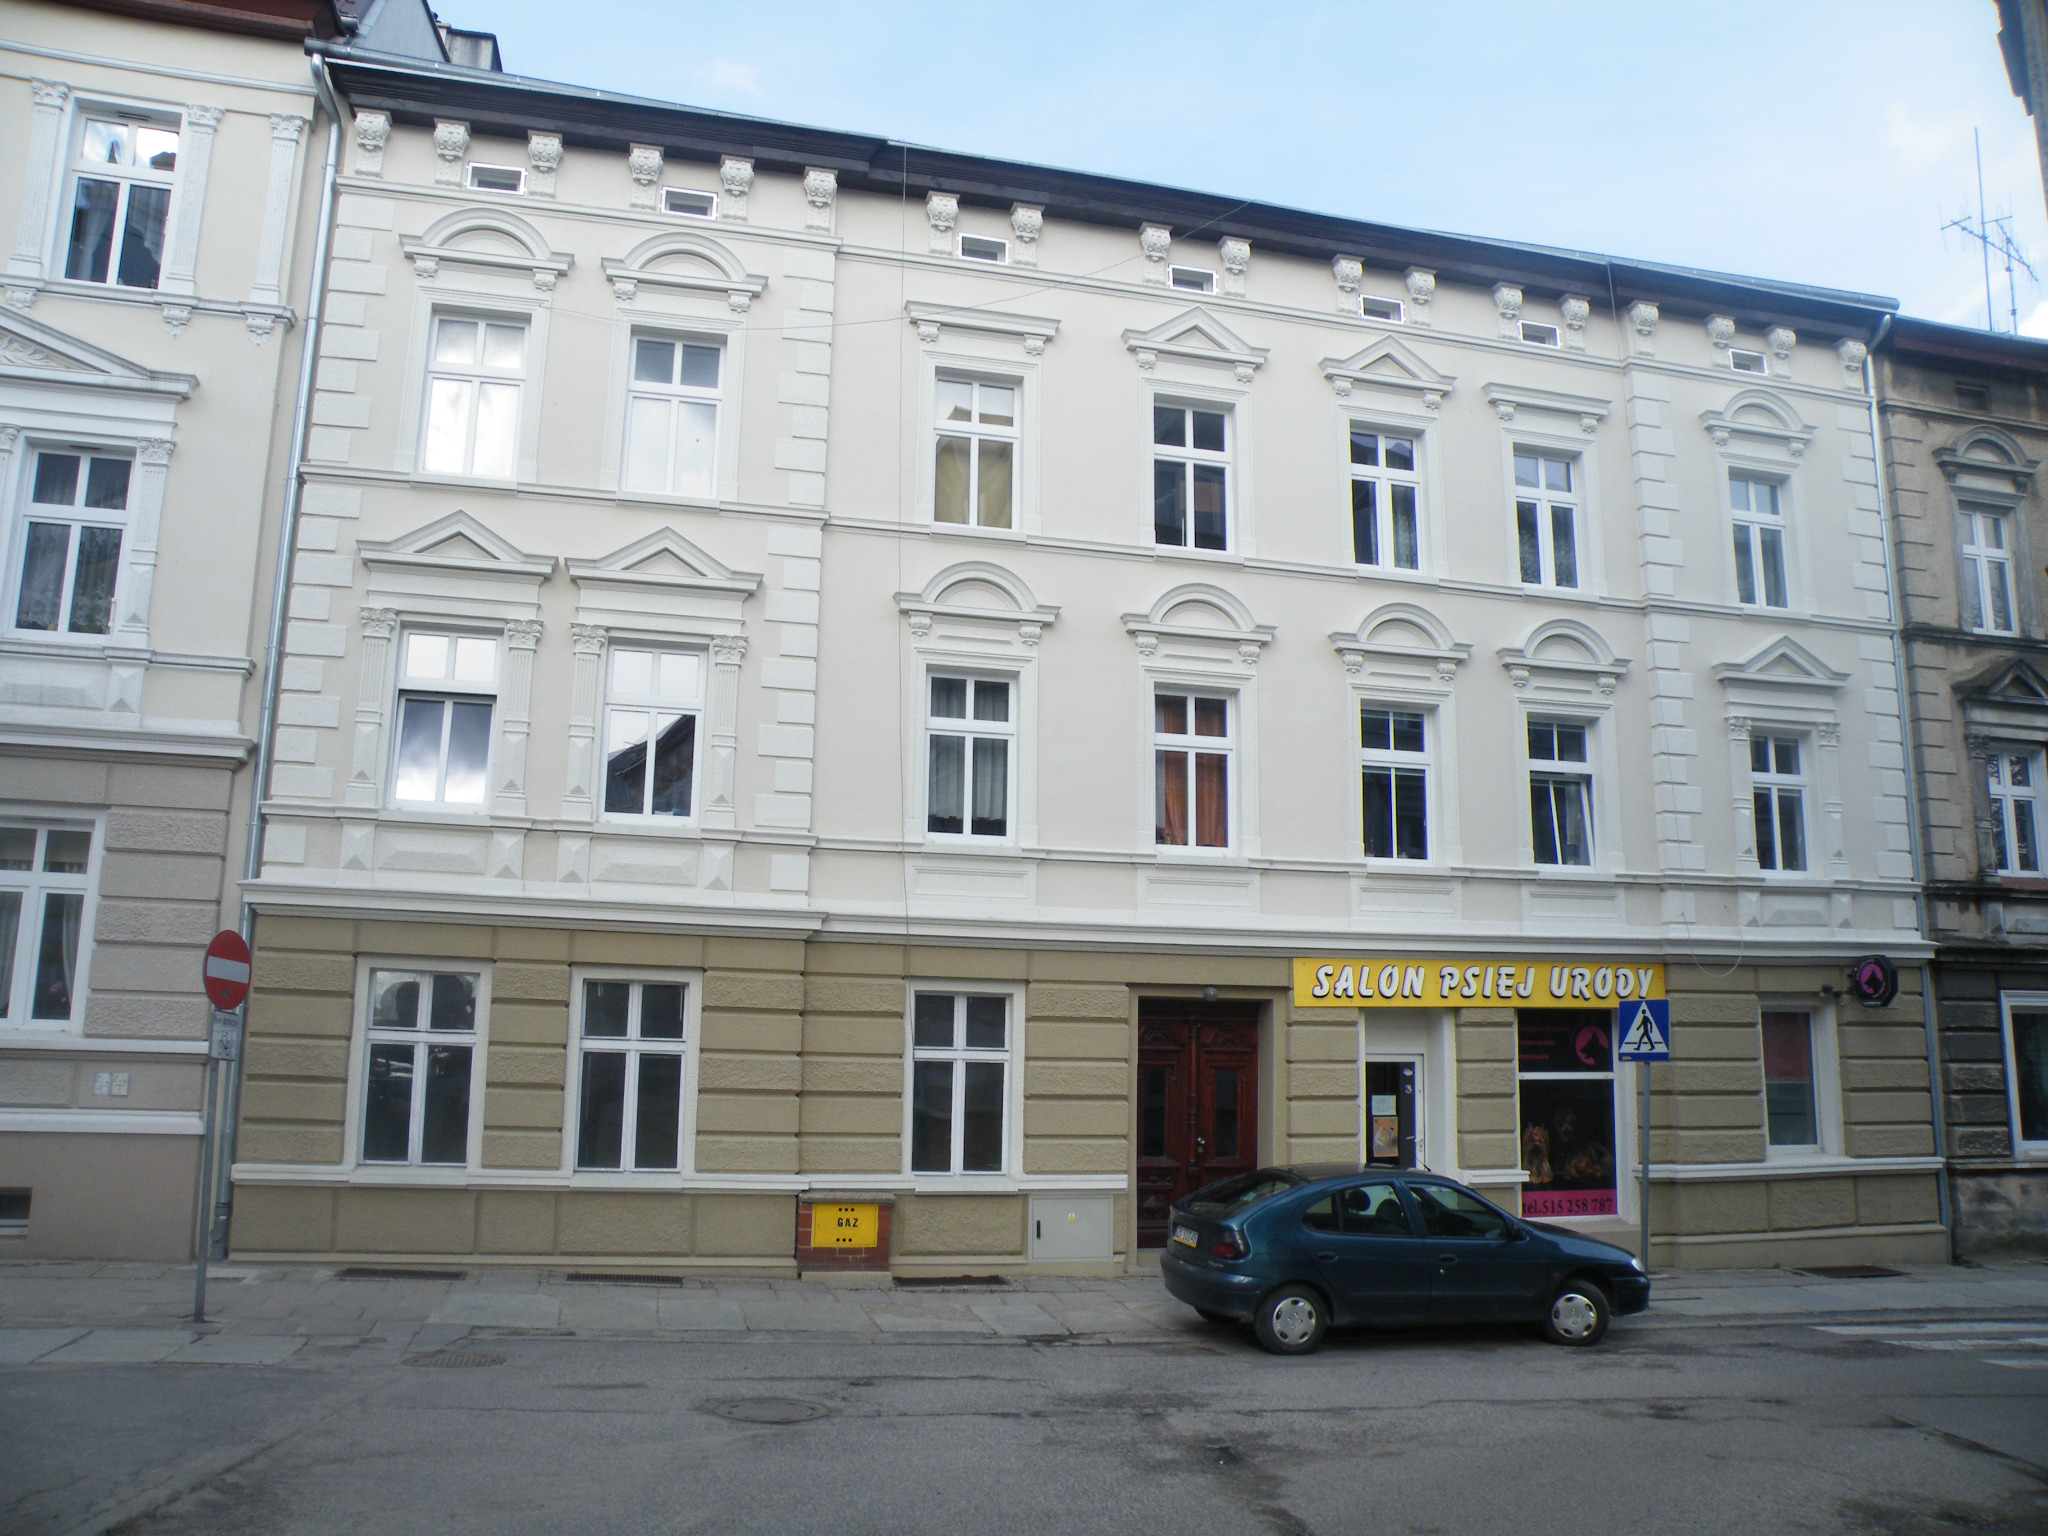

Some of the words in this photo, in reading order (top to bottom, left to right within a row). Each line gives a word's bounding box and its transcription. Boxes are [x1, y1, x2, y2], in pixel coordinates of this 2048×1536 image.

[1312, 964, 1425, 999] SALON
[1439, 965, 1535, 998] PSIEJ
[1550, 967, 1653, 1000] URODY
[1567, 1198, 1589, 1213] 258
[1591, 1198, 1613, 1213] 787
[837, 1218, 858, 1227] GAZ
